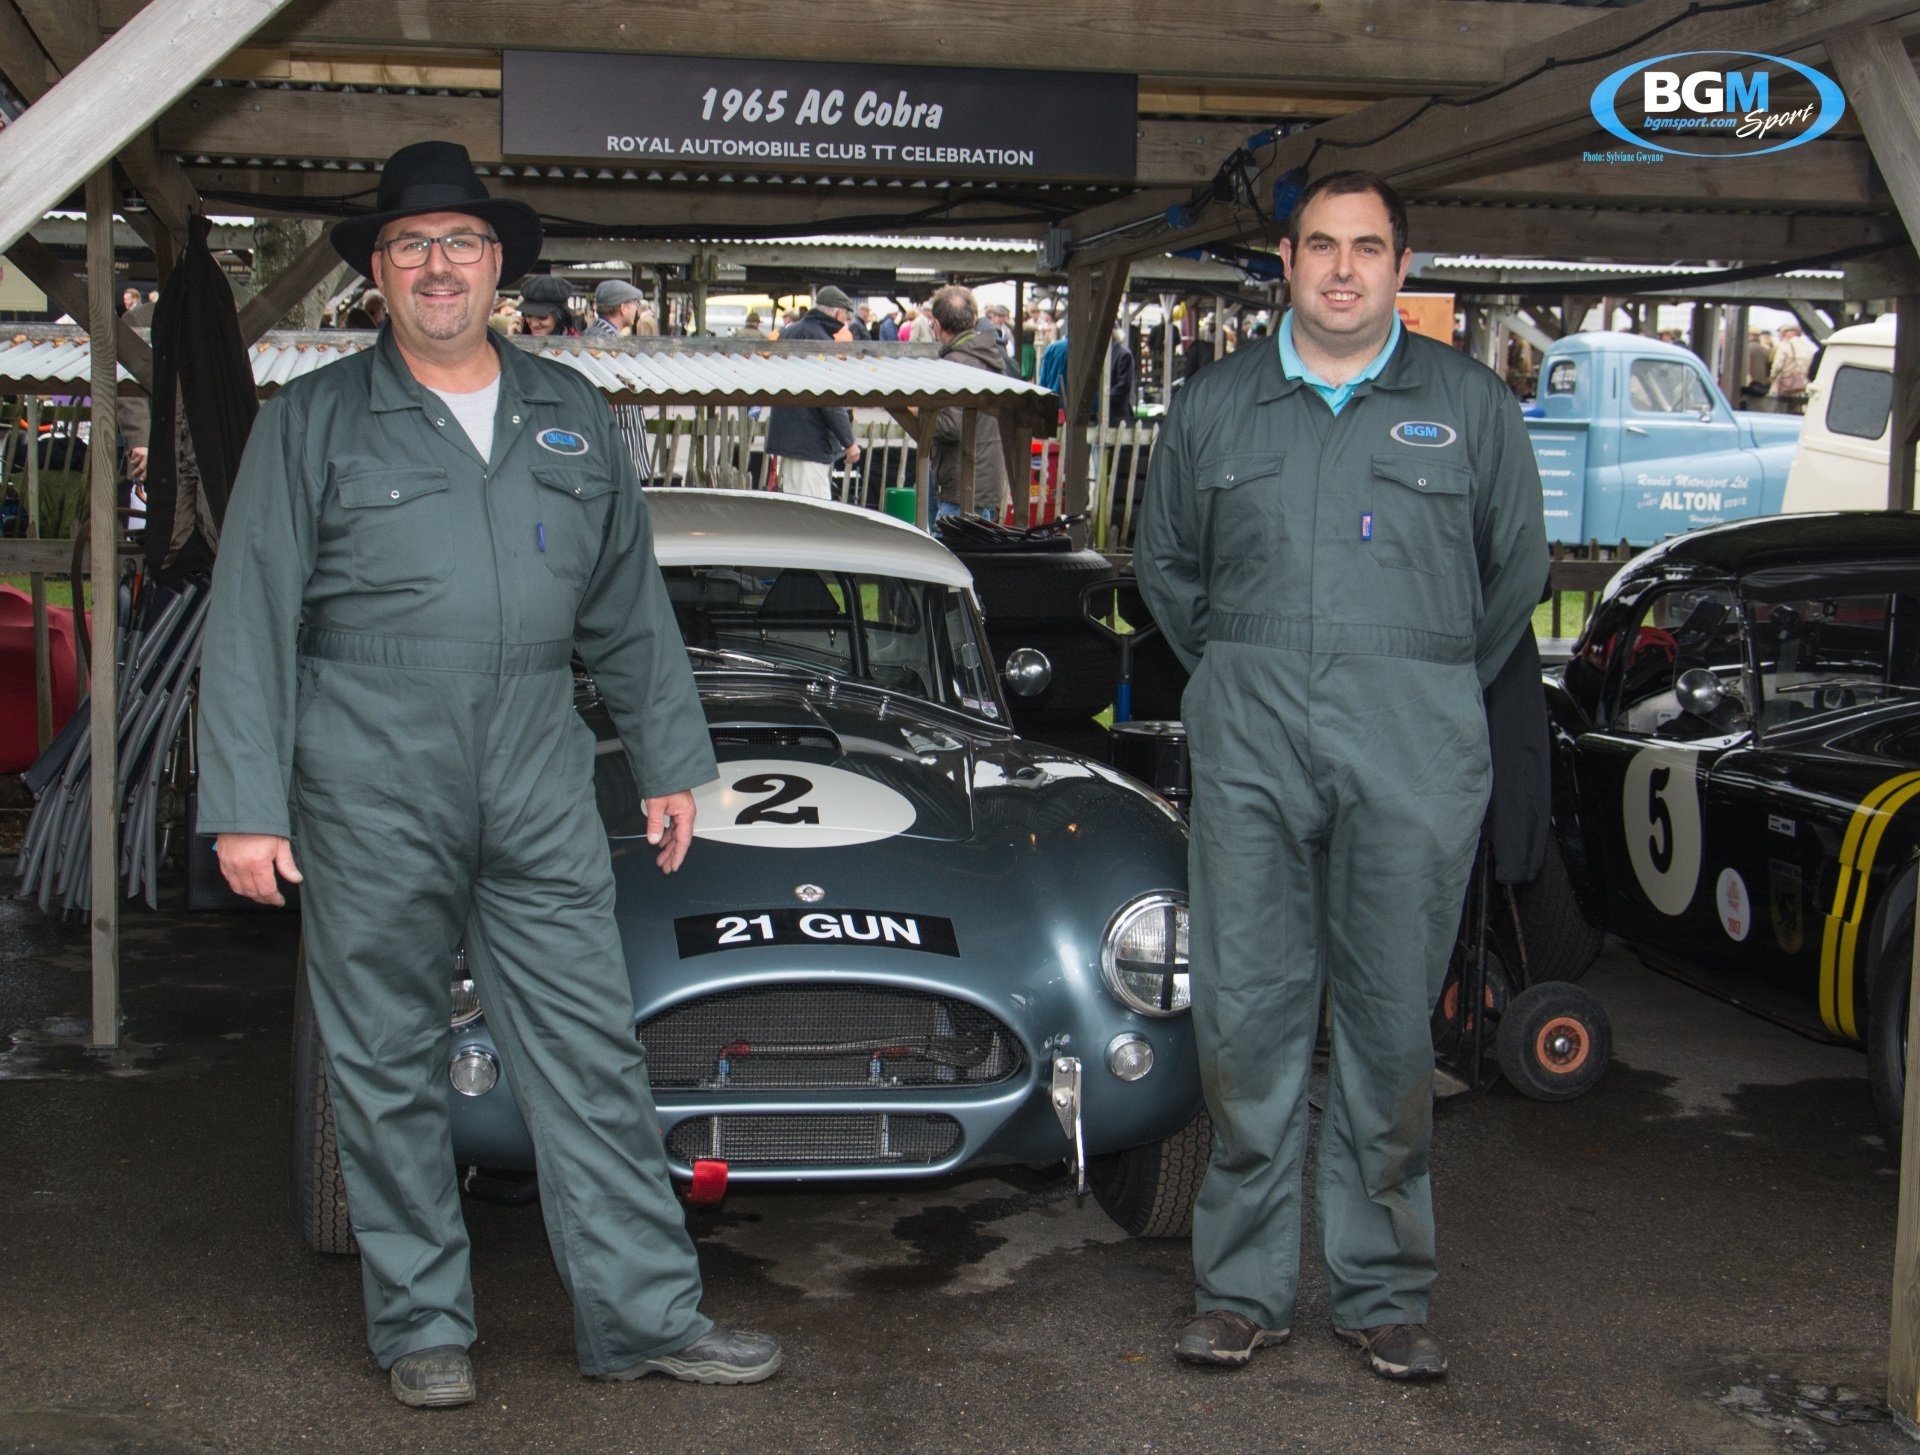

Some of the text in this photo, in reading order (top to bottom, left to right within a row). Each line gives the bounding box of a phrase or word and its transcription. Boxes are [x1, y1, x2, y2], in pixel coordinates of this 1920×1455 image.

[701, 87, 942, 130] 1965 AC Cobra
[607, 135, 1034, 167] ROYAL AUTOMOBILE CLUB TT CELEBRATION
[1403, 424, 1438, 438] BGM
[1542, 488, 1564, 497] EPAIR
[1660, 491, 1723, 511] ALTON
[732, 773, 820, 825] 2
[1648, 767, 1673, 874] 5
[715, 913, 921, 945] 21 GUN
